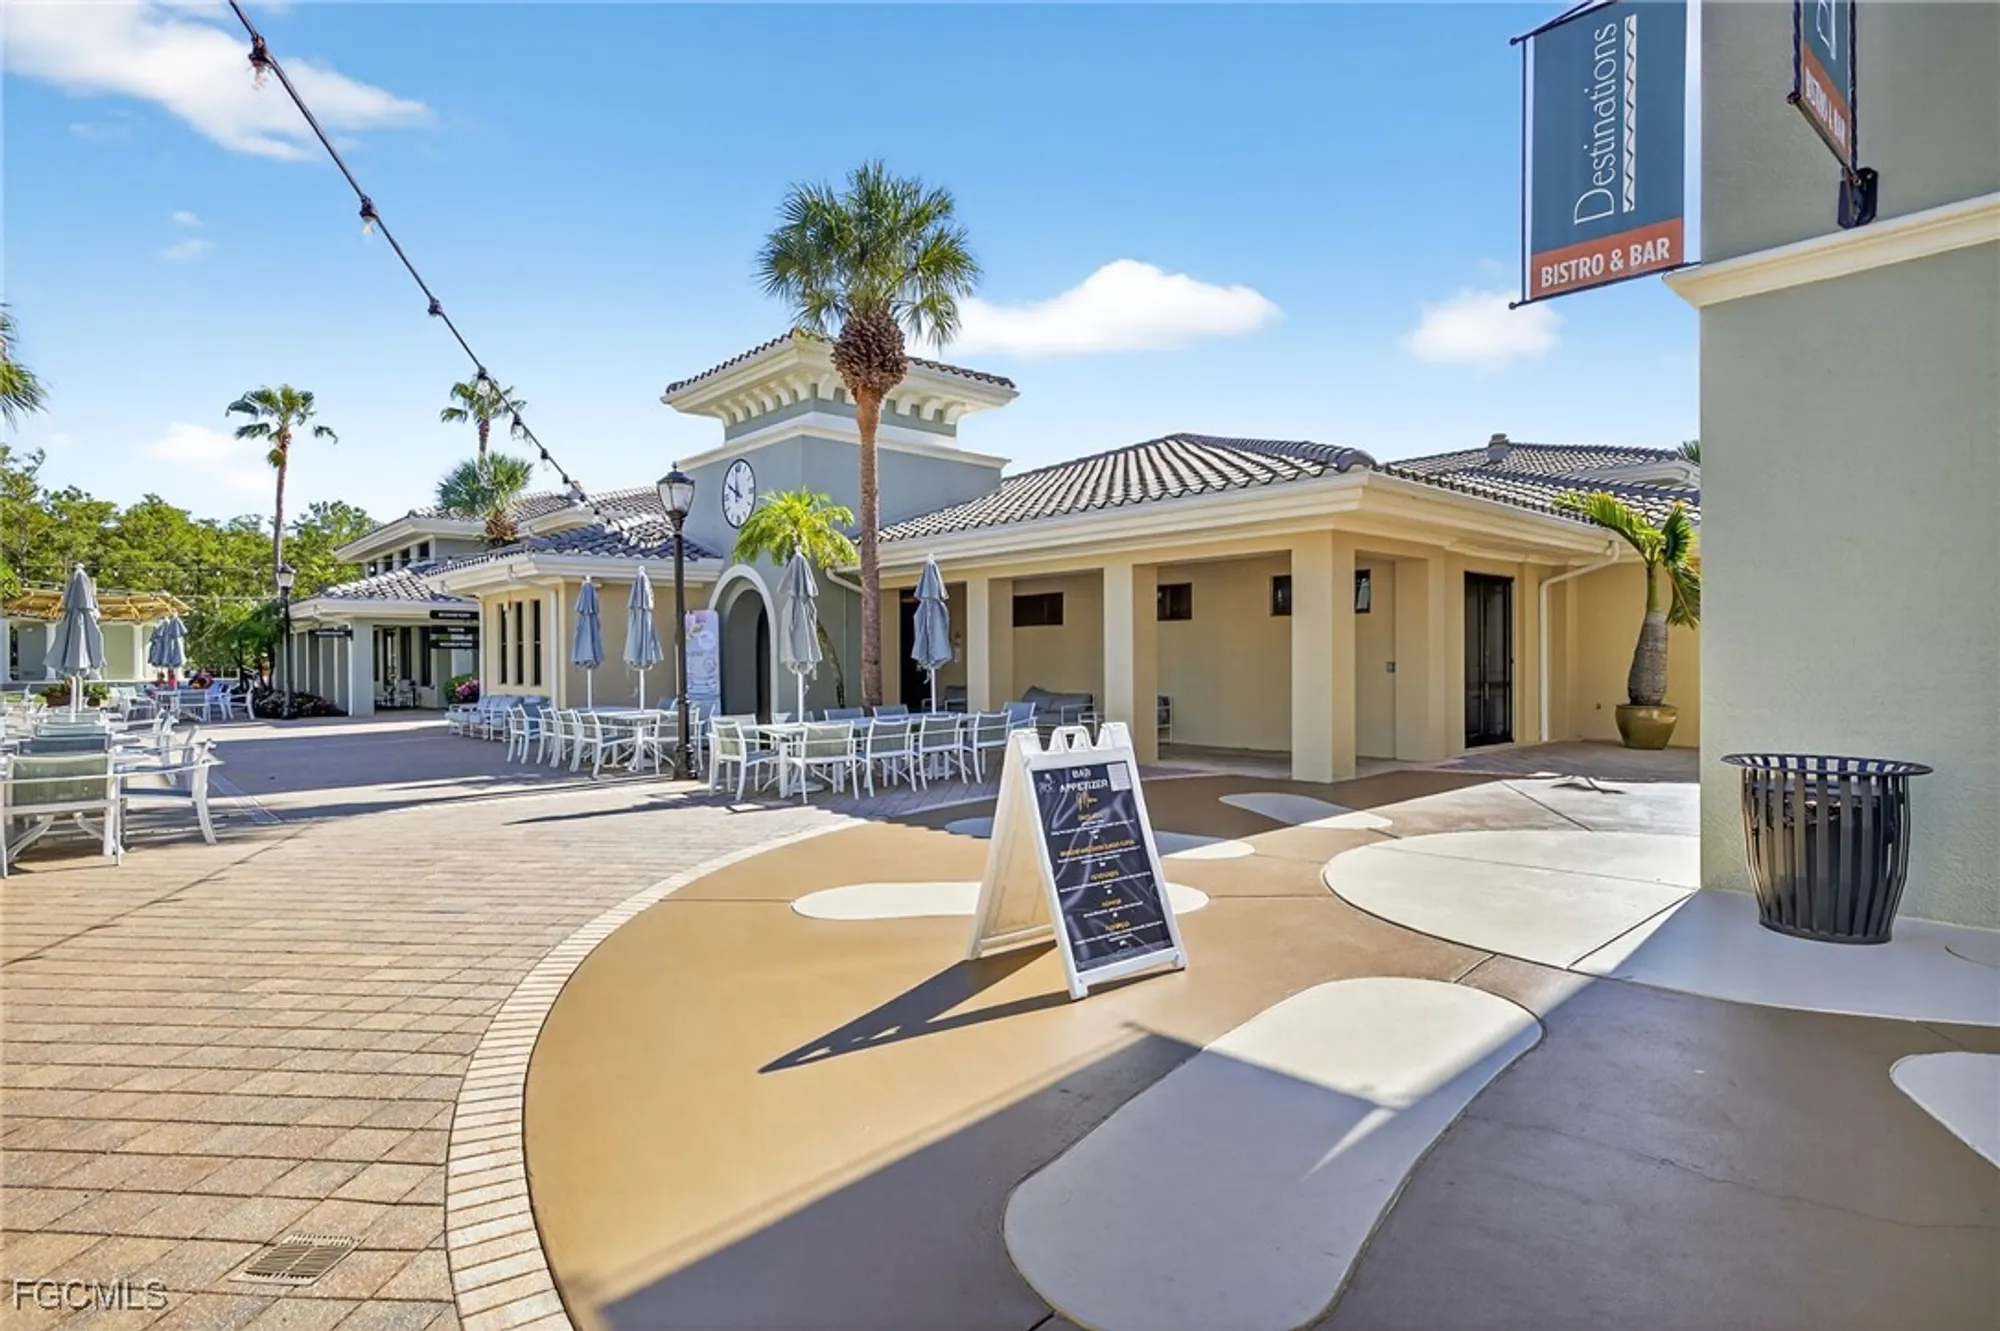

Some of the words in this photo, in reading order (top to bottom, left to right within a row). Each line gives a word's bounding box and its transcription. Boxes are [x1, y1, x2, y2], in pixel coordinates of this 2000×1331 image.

[1574, 23, 1618, 225] Destinations
[1541, 254, 1604, 288] BISTRO
[1610, 248, 1624, 271] &
[1629, 237, 1670, 267] BAR
[1060, 779, 1108, 793] APPETIZER
[1071, 768, 1092, 779] BAR
